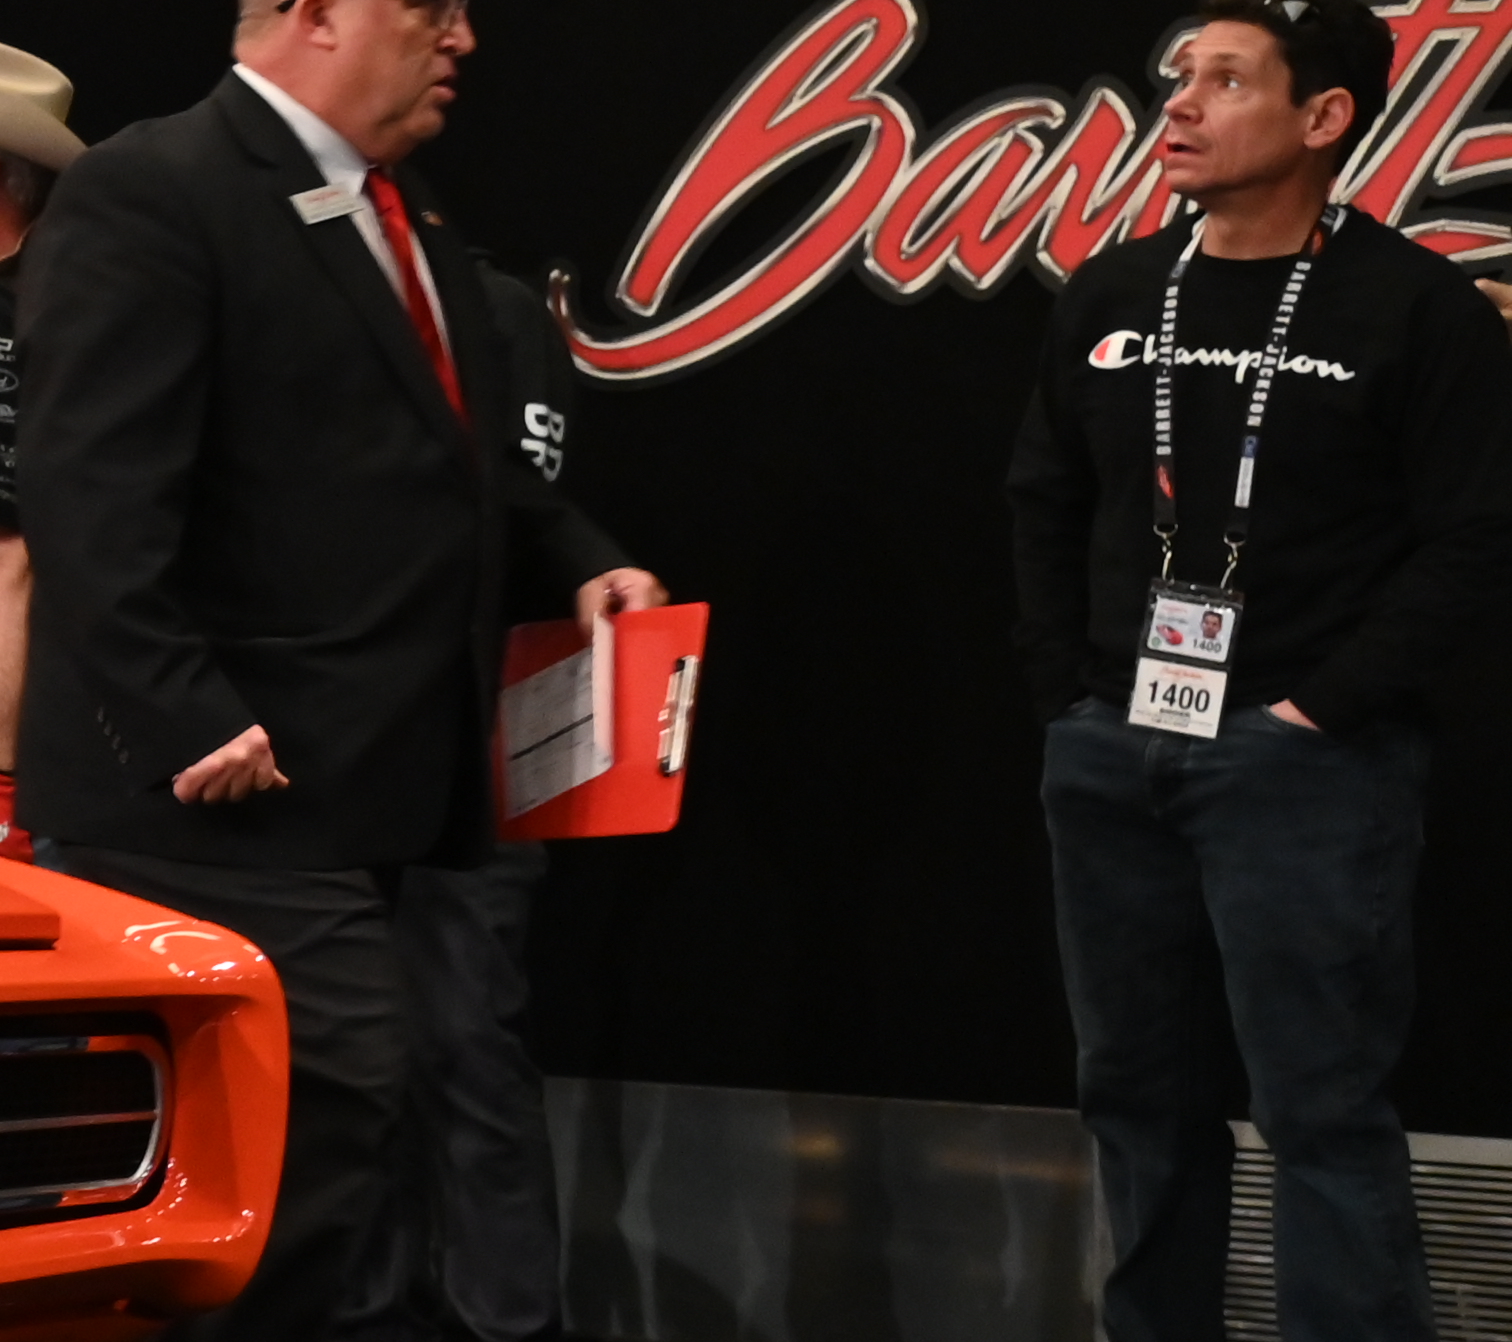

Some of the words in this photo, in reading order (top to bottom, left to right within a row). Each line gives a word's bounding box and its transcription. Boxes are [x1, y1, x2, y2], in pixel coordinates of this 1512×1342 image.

[1088, 329, 1355, 385] Champion
[1193, 638, 1223, 654] 1400
[1149, 680, 1211, 714] 1400
